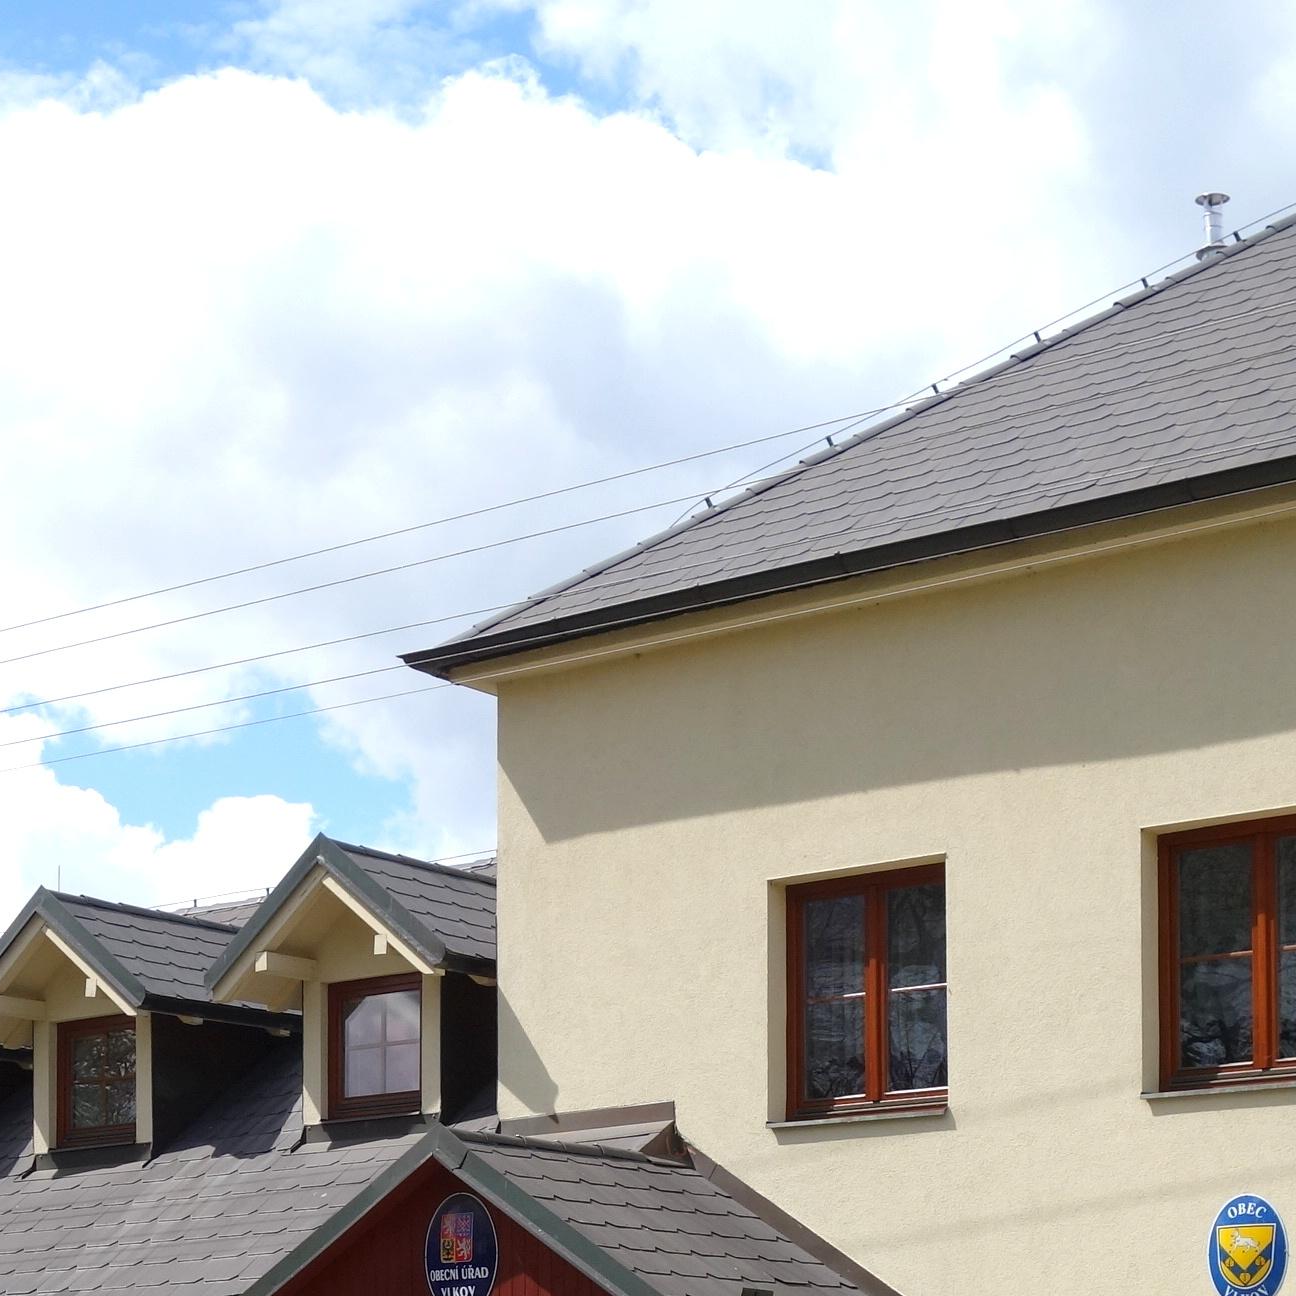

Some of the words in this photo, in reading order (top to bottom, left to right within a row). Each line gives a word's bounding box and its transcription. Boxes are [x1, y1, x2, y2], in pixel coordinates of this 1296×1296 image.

[1227, 1202, 1267, 1219] OBEC
[430, 1265, 460, 1282] OBECNÍ
[461, 1264, 490, 1280] ÚŘAD
